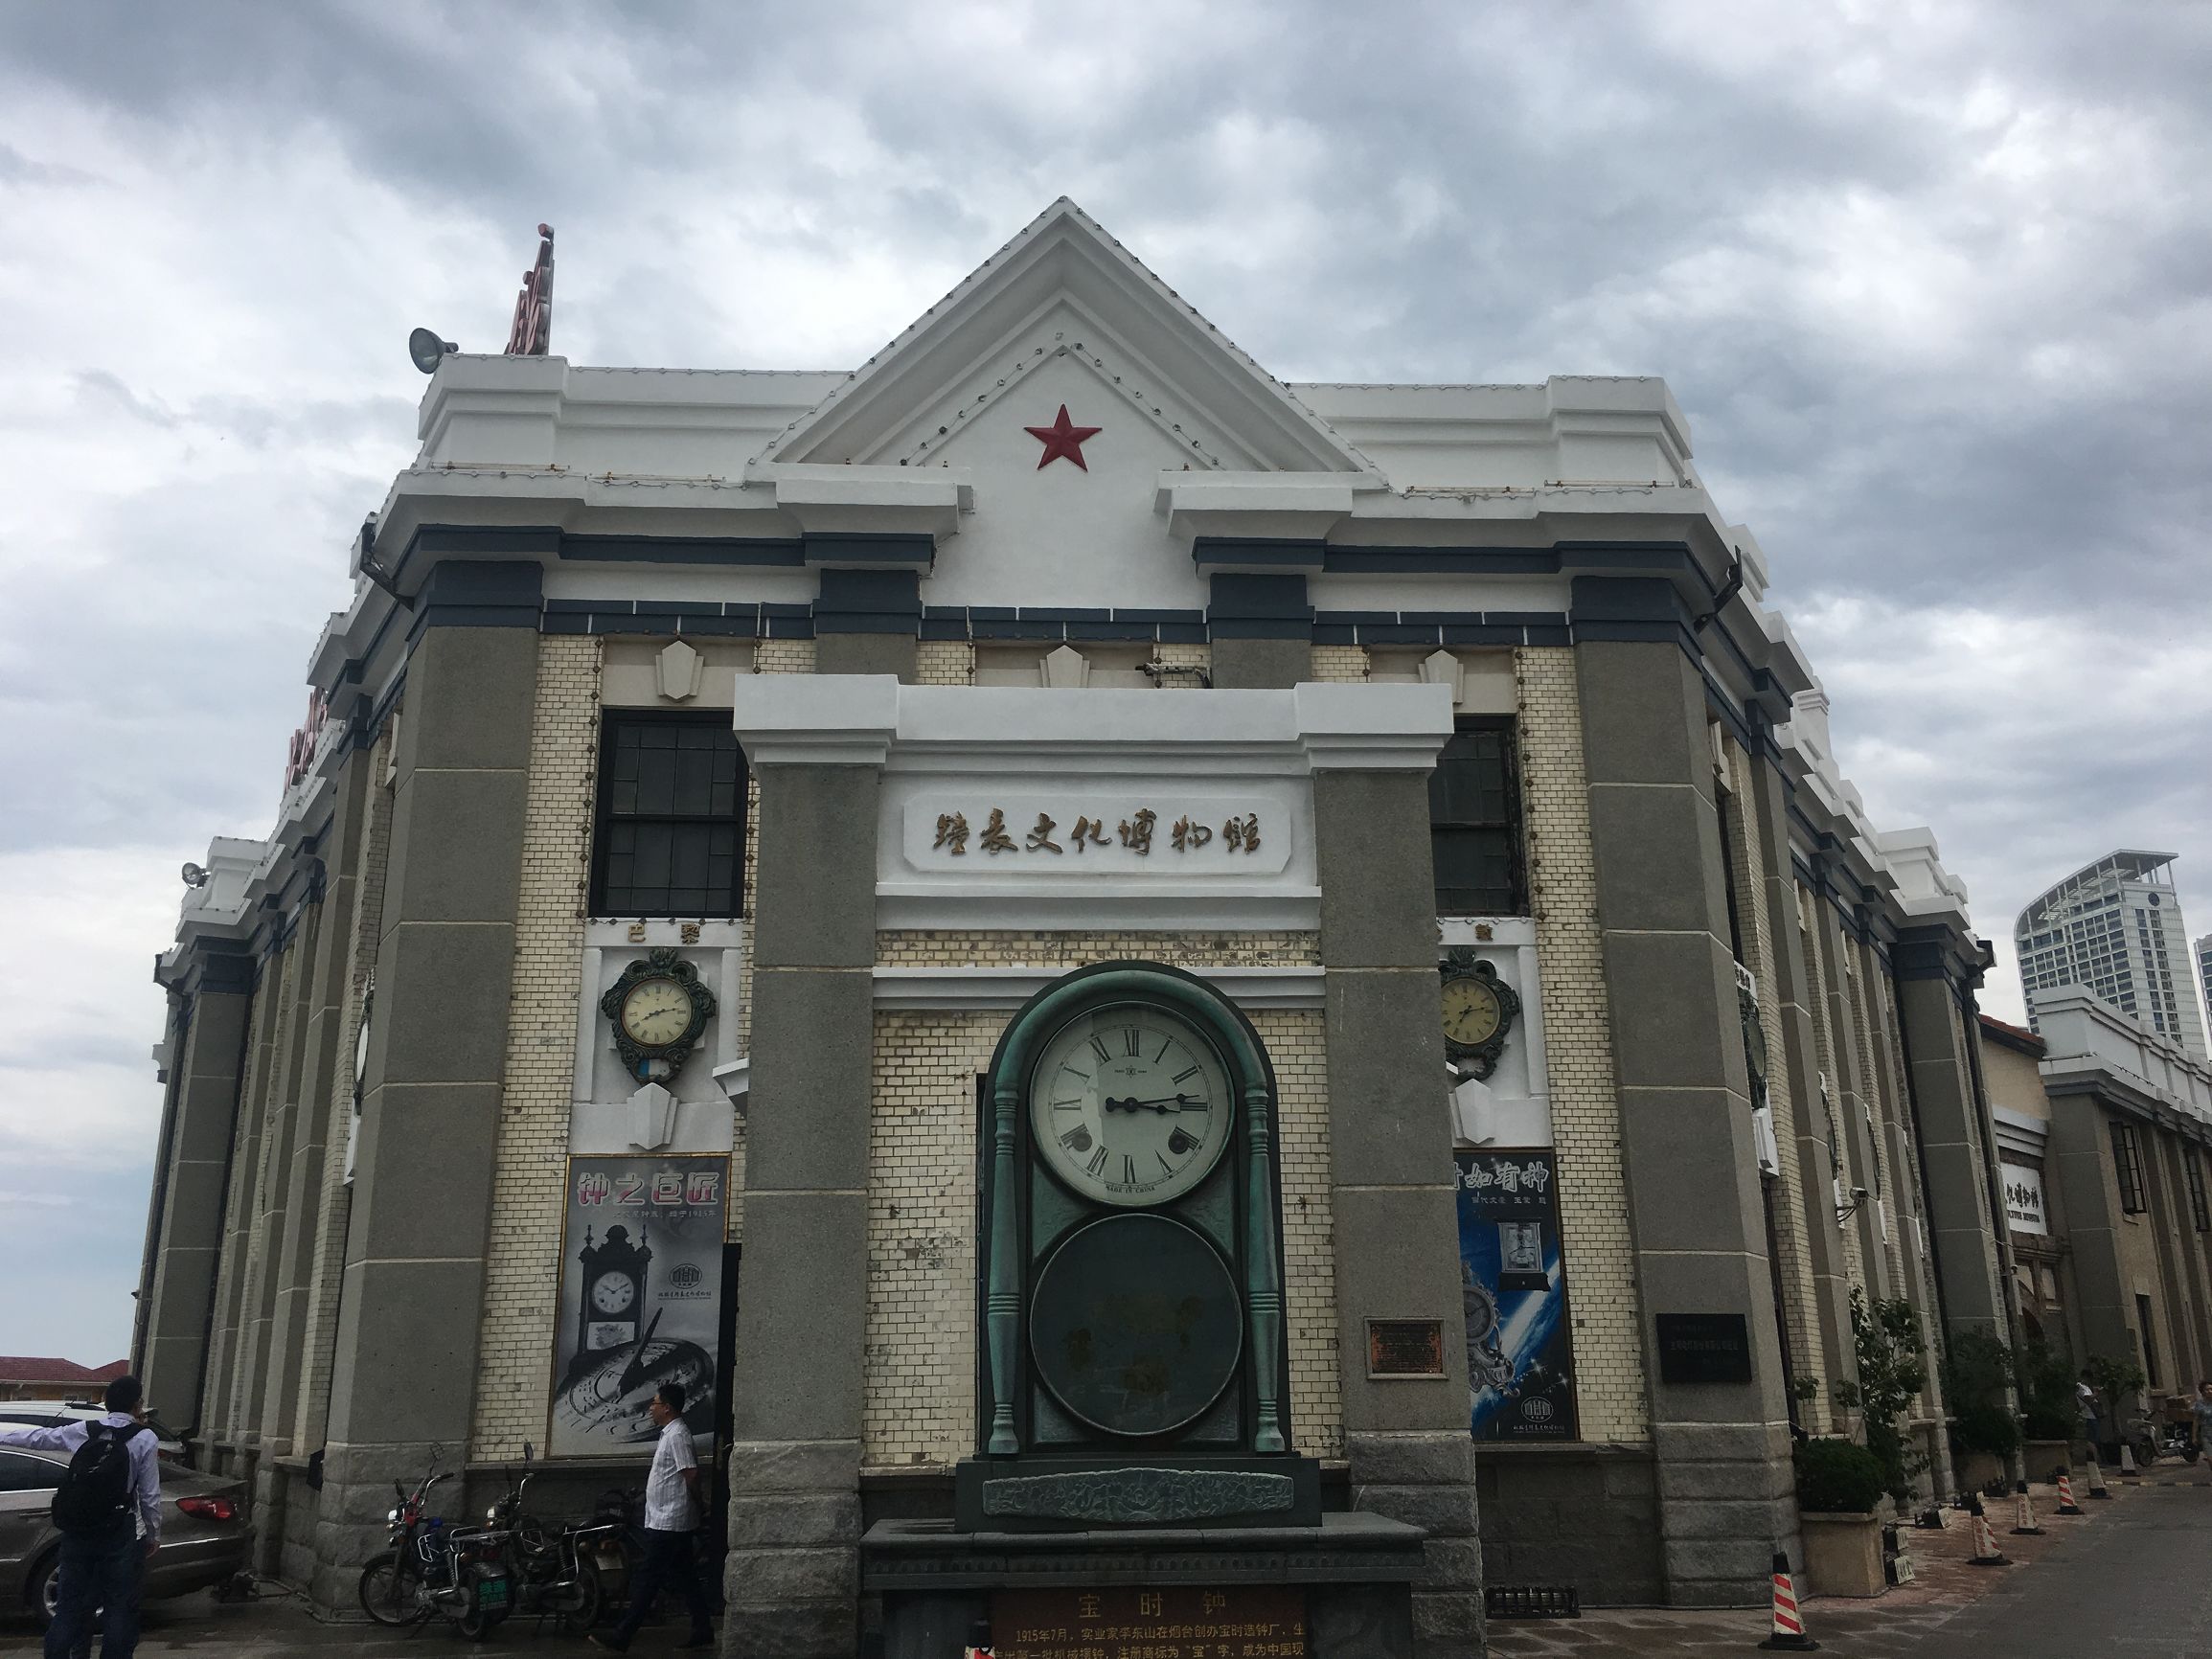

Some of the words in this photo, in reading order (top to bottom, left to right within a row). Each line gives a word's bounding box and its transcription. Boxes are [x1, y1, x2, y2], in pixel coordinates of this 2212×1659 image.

[578, 1171, 720, 1206] 钟之巨匠
[1106, 1185, 1122, 1193] MADE
[1135, 1185, 1155, 1193] CHINA
[1079, 1590, 1226, 1618] 宝时钟
